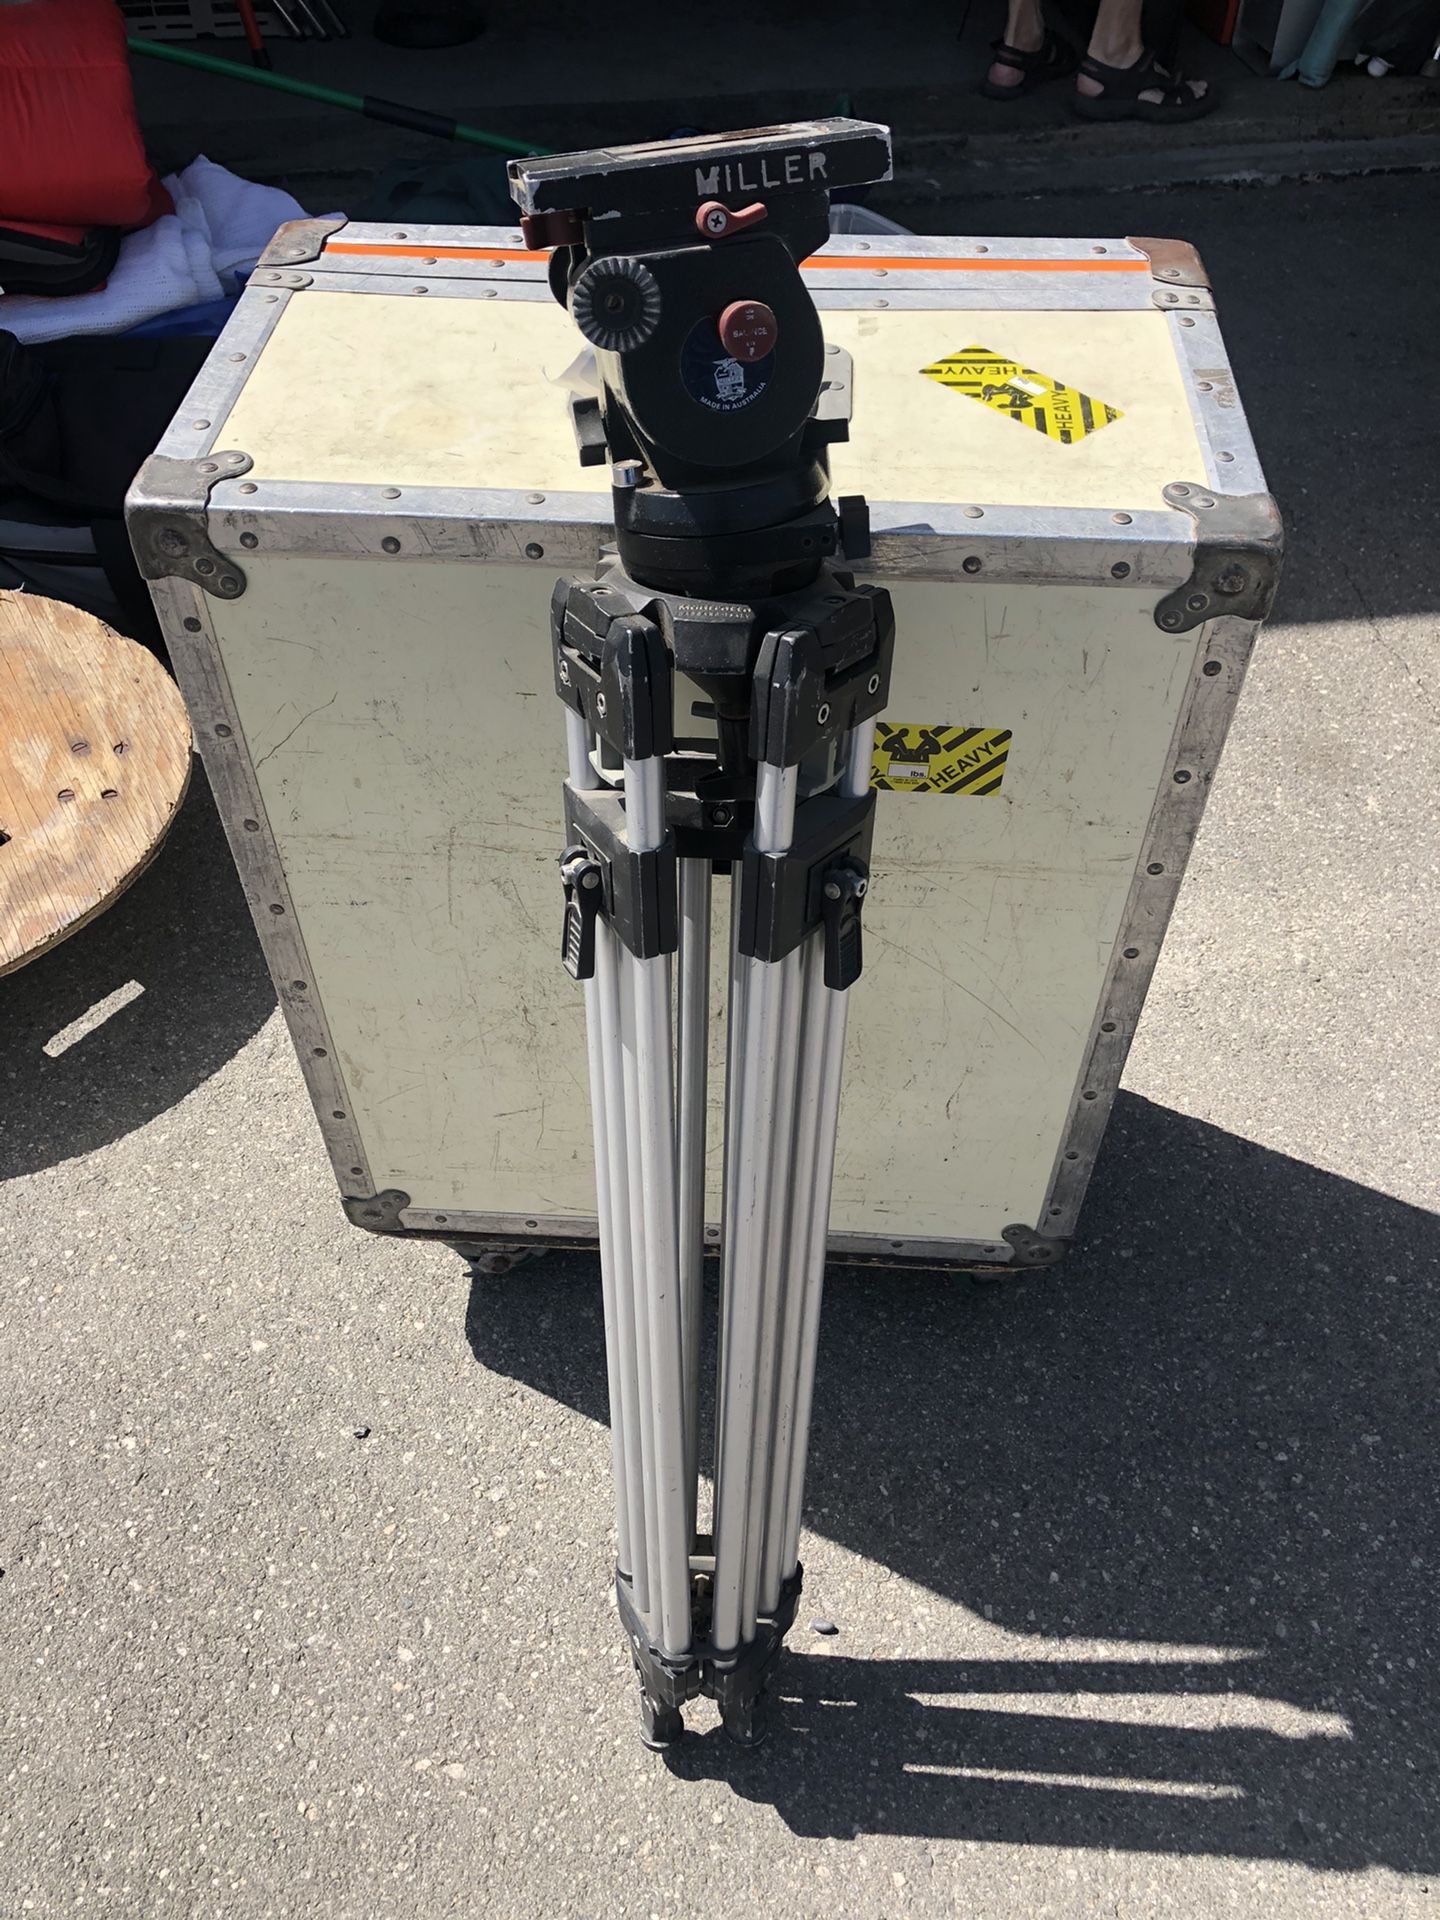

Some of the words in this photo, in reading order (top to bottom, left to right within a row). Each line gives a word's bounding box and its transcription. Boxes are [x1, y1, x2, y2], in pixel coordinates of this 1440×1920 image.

[695, 151, 829, 195] MILLER
[733, 327, 768, 338] BALNCE
[943, 366, 1017, 375] HEAVY
[700, 396, 721, 410] MADE
[732, 382, 767, 409] AUSTRALIA
[1054, 390, 1074, 429] HEAVY
[910, 770, 927, 778] lbs.
[929, 741, 994, 788] HEAVY
